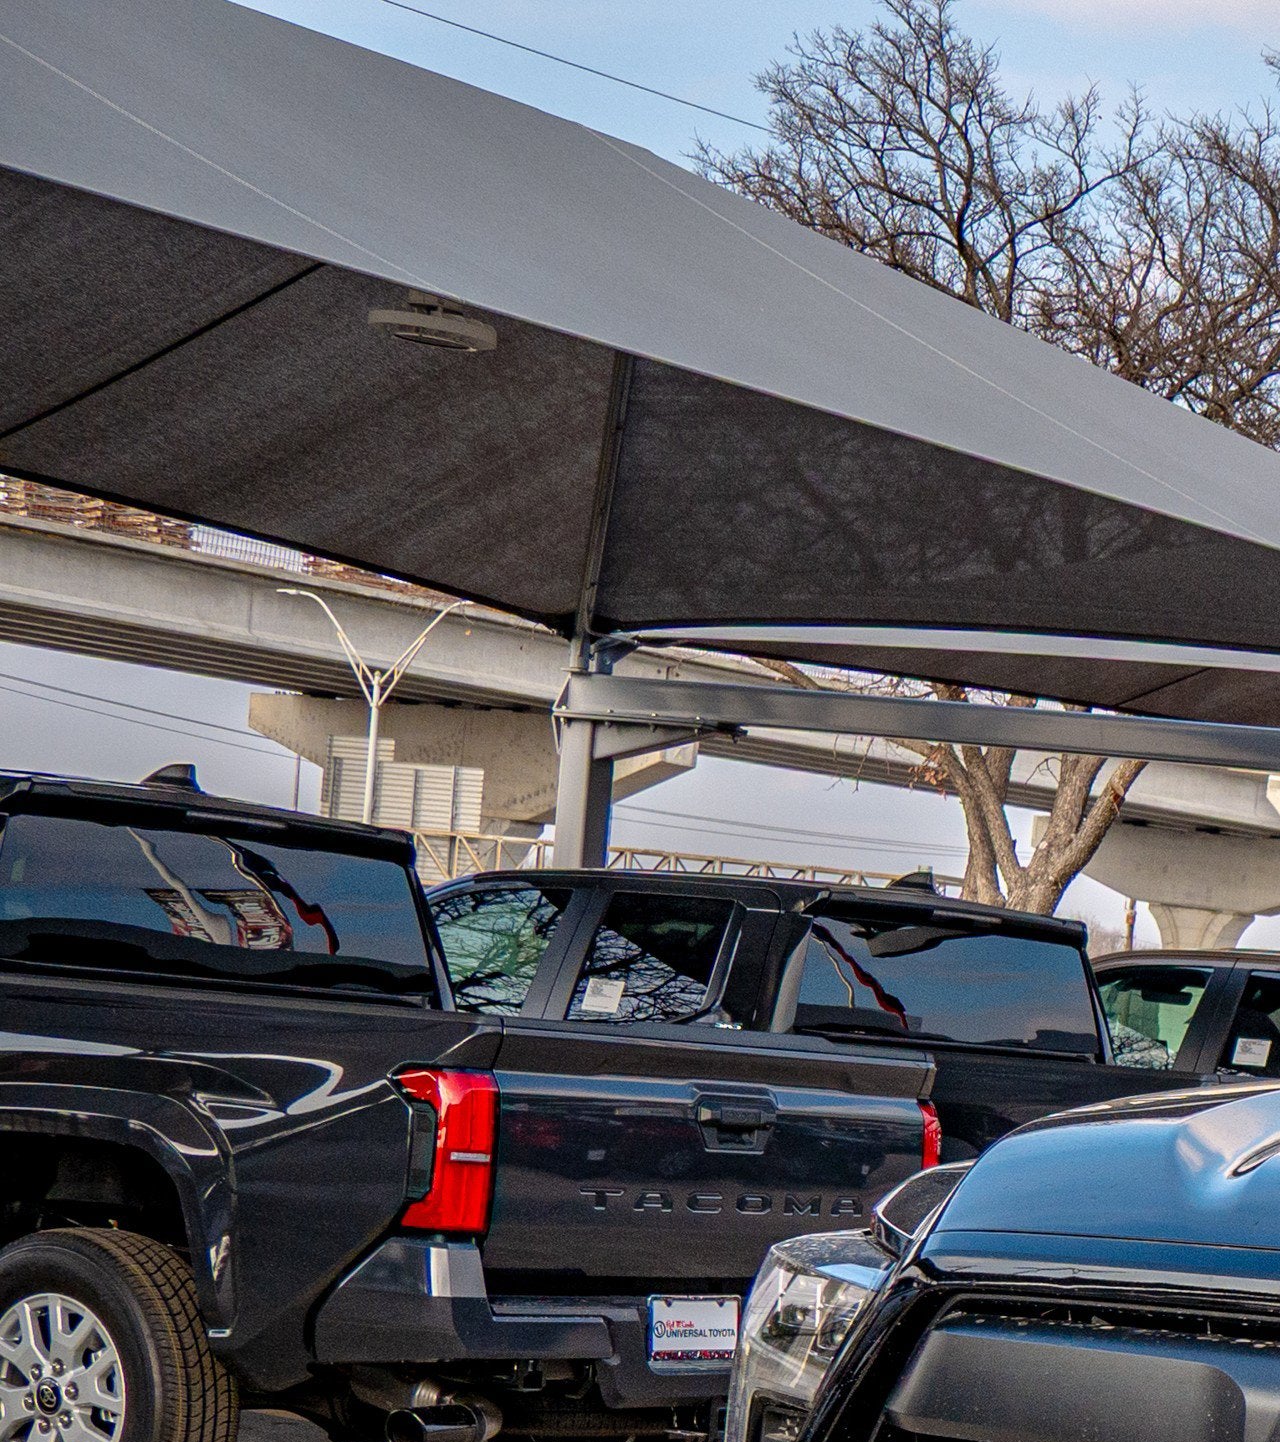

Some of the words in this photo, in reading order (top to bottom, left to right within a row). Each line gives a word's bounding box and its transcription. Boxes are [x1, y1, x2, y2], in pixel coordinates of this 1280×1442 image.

[578, 1186, 863, 1218] TACOMA
[666, 1328, 708, 1338] UNIVERSAL
[709, 1328, 736, 1338] TOYOTA
